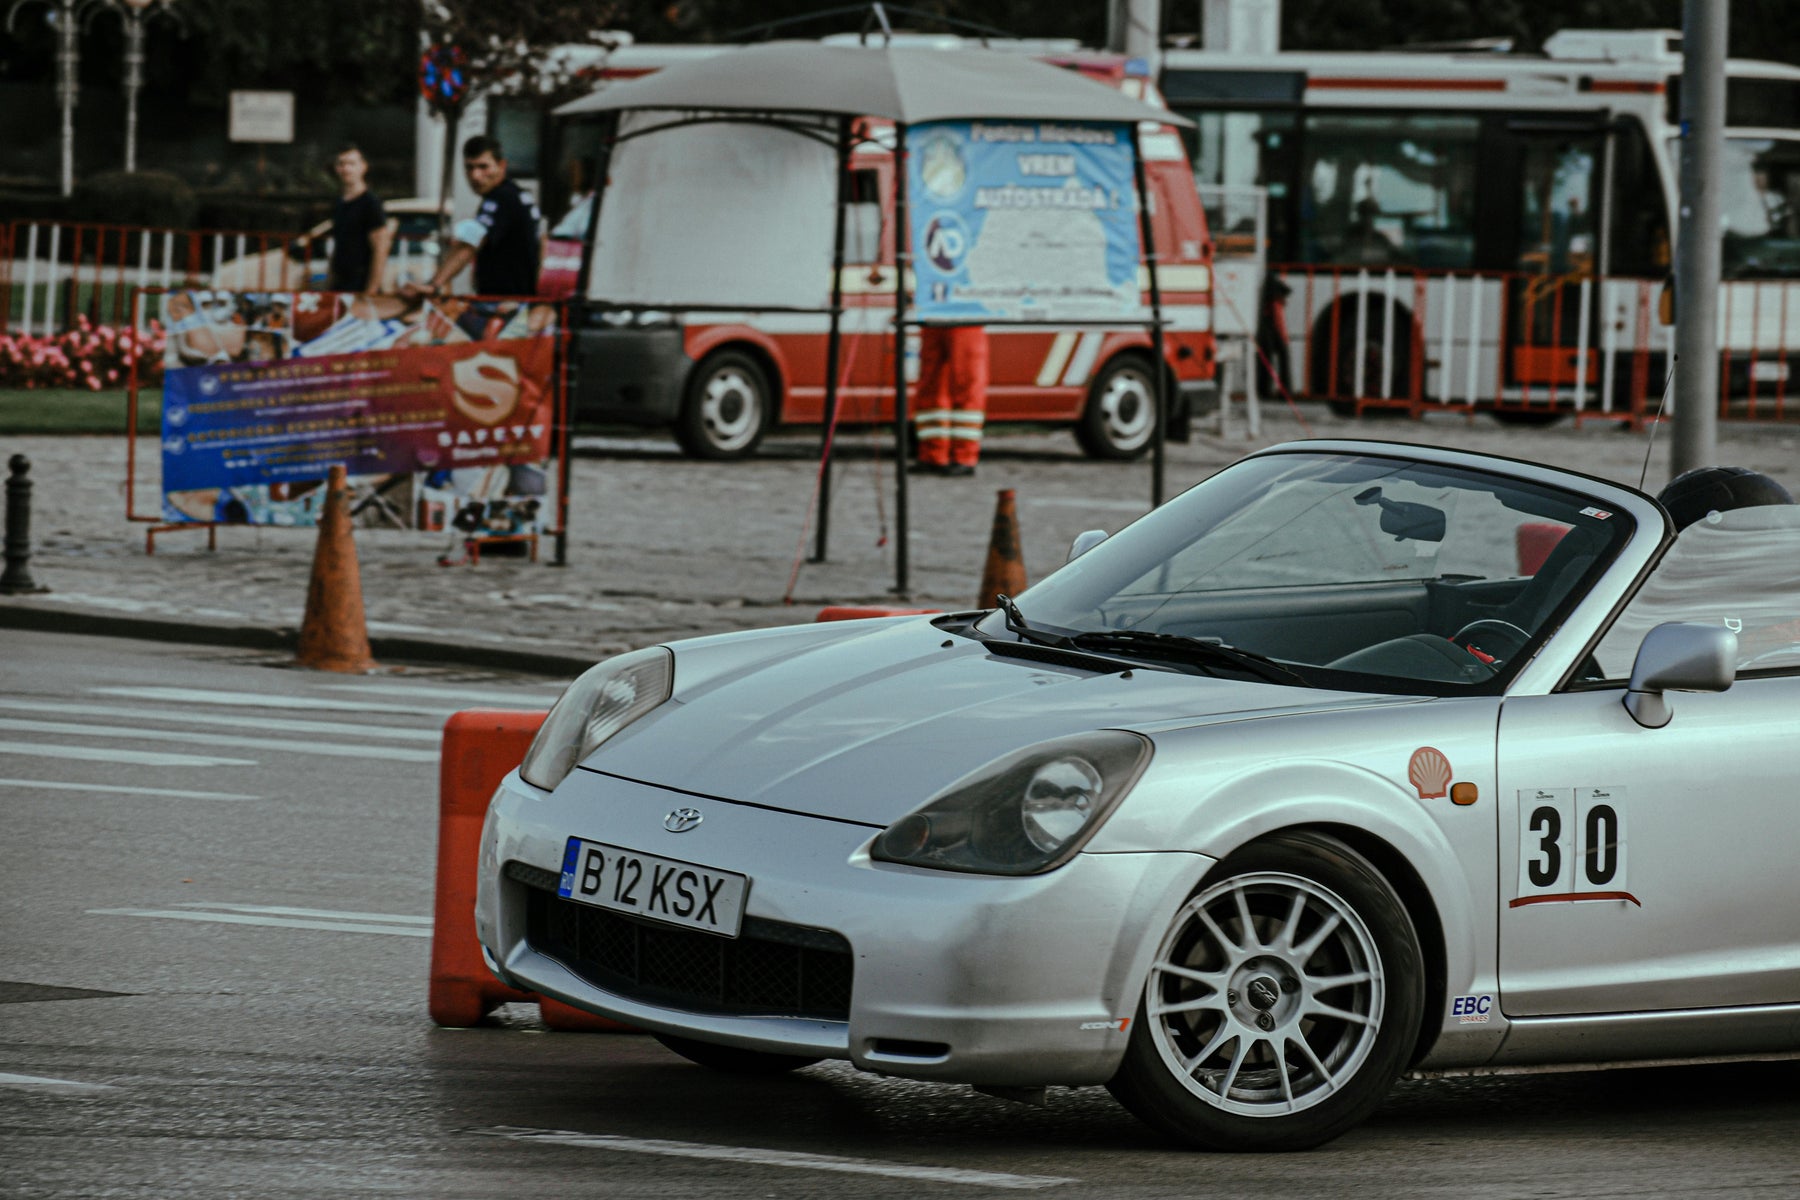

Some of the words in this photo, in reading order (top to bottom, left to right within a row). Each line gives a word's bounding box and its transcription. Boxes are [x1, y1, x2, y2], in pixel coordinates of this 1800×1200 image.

[971, 124, 1035, 142] Pentru
[1018, 154, 1076, 176] VREM
[437, 424, 545, 447] SAFETY
[580, 848, 605, 896] B
[614, 856, 643, 906] 12
[648, 864, 725, 925] KSX
[1452, 995, 1492, 1015] EBC
